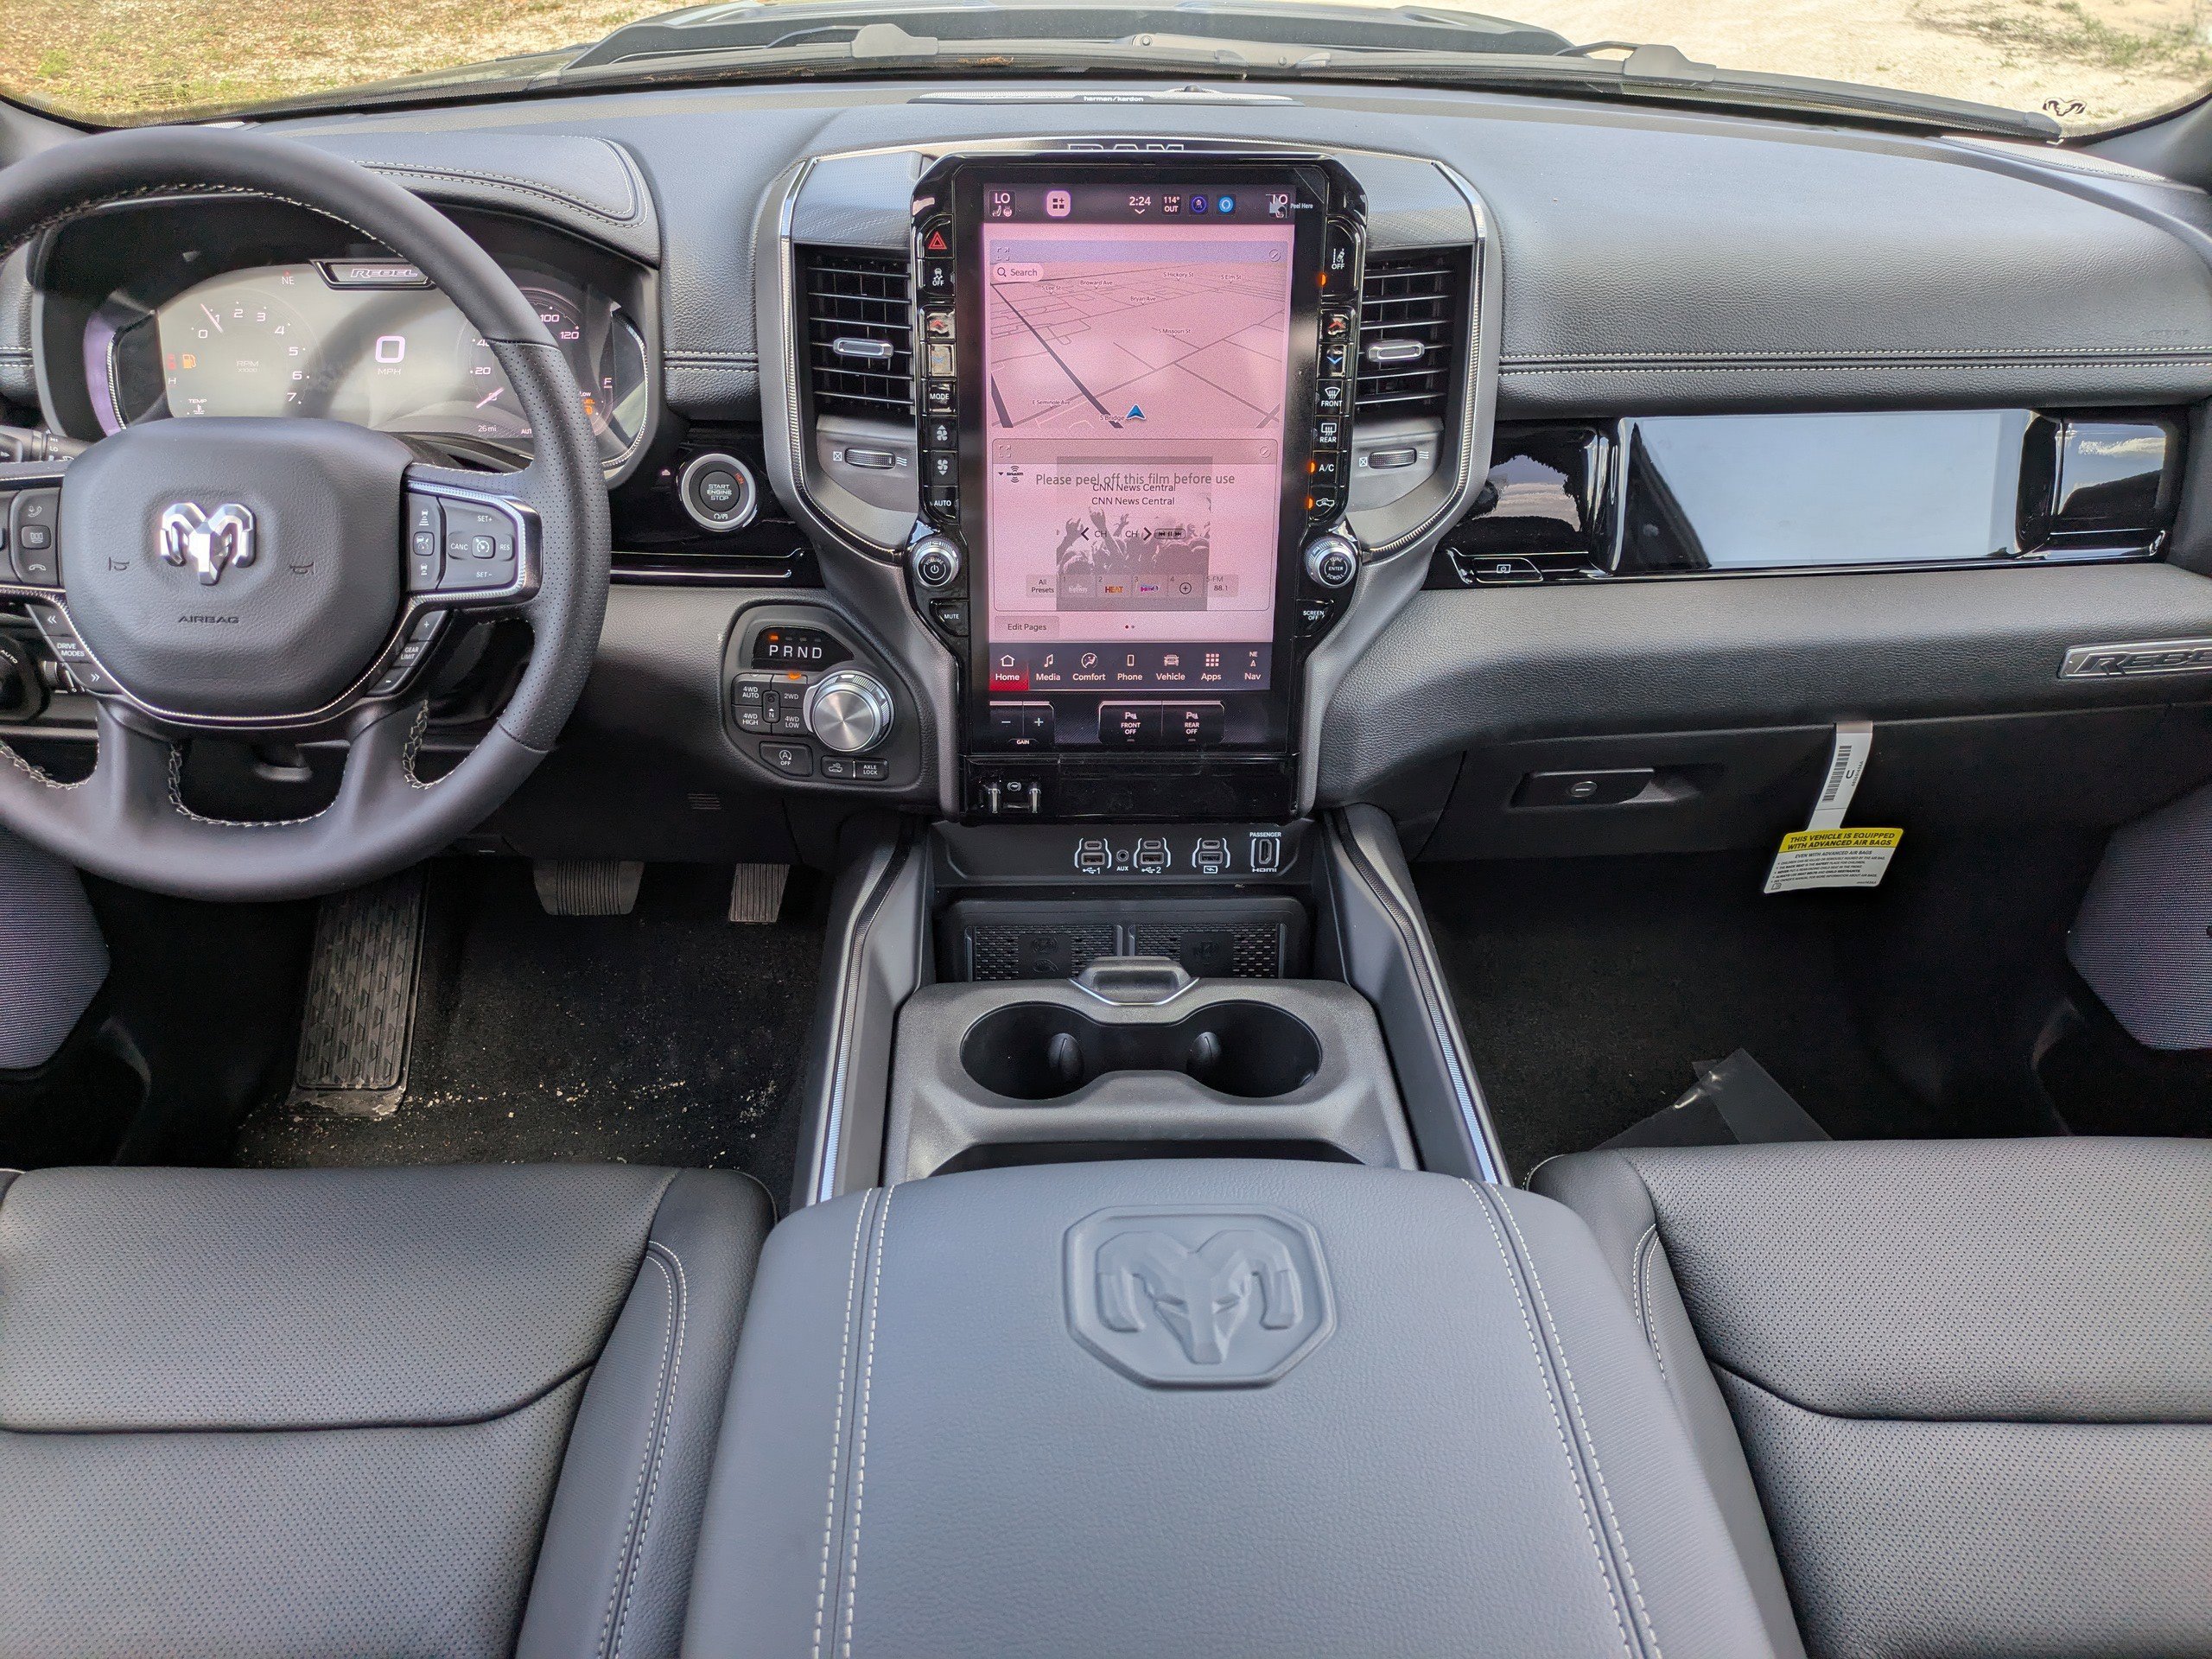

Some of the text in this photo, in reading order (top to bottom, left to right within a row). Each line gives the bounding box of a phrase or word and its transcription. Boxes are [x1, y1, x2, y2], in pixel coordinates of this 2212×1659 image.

[995, 193, 1010, 204] LO
[1129, 196, 1151, 207] 2:24
[350, 268, 418, 278] REBEL
[282, 276, 295, 285] NE
[233, 309, 244, 318] 2
[257, 313, 266, 321] 3
[198, 330, 208, 339] 0
[274, 326, 285, 335] 4
[289, 346, 299, 356] 5
[375, 336, 405, 364] 0
[287, 392, 297, 402] 7
[1319, 463, 1335, 472] A/C
[1036, 474, 1071, 485] Please
[1076, 474, 1099, 487] peel
[1103, 474, 1120, 485] off
[1124, 474, 1144, 485] this
[1148, 474, 1169, 484] film
[1174, 473, 1211, 484] before
[1142, 483, 1176, 492] Central
[925, 556, 944, 565] VOLUME
[178, 615, 240, 624] AIRBAG
[1024, 623, 1047, 632] Pages
[0, 650, 18, 664] AUTO
[2074, 648, 2212, 676] REBE
[1036, 672, 1060, 681] Media
[1072, 672, 1106, 681] Comfort
[1155, 672, 1185, 681] Vehicle
[1201, 673, 1222, 683] Apps
[1846, 770, 1854, 779] U
[1809, 833, 1842, 842] VEHICLE
[1808, 840, 1852, 849] ADVANCED
